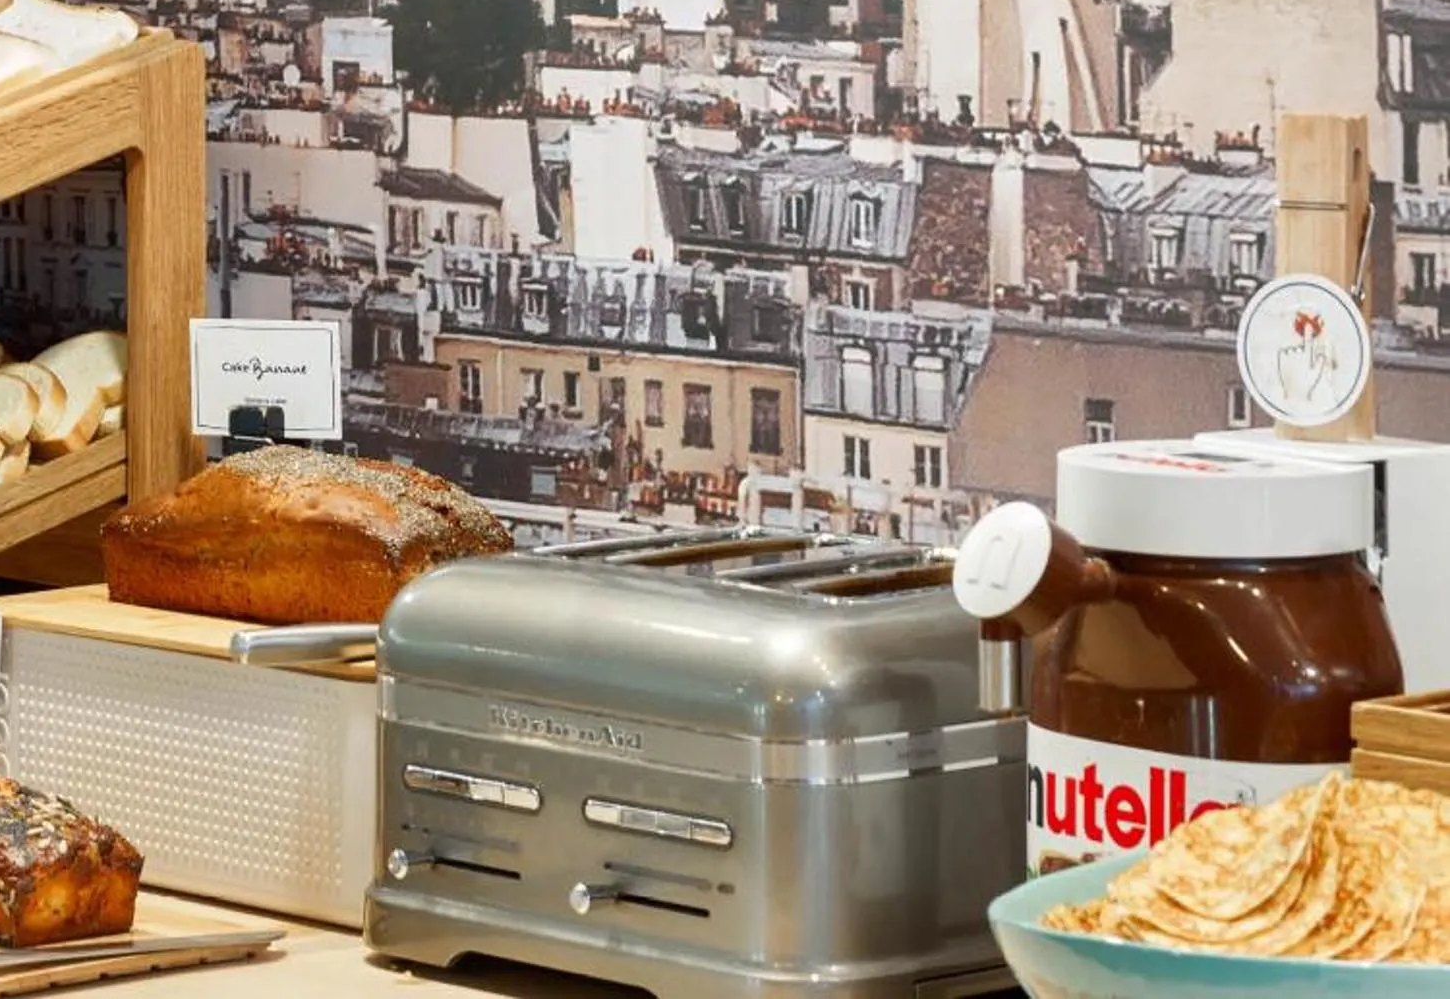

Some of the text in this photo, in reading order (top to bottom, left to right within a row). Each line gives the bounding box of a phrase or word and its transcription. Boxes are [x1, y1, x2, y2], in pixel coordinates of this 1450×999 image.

[221, 355, 307, 380] Cake Banane
[488, 703, 646, 752] KitchenAid
[1027, 761, 1241, 850] nutell
